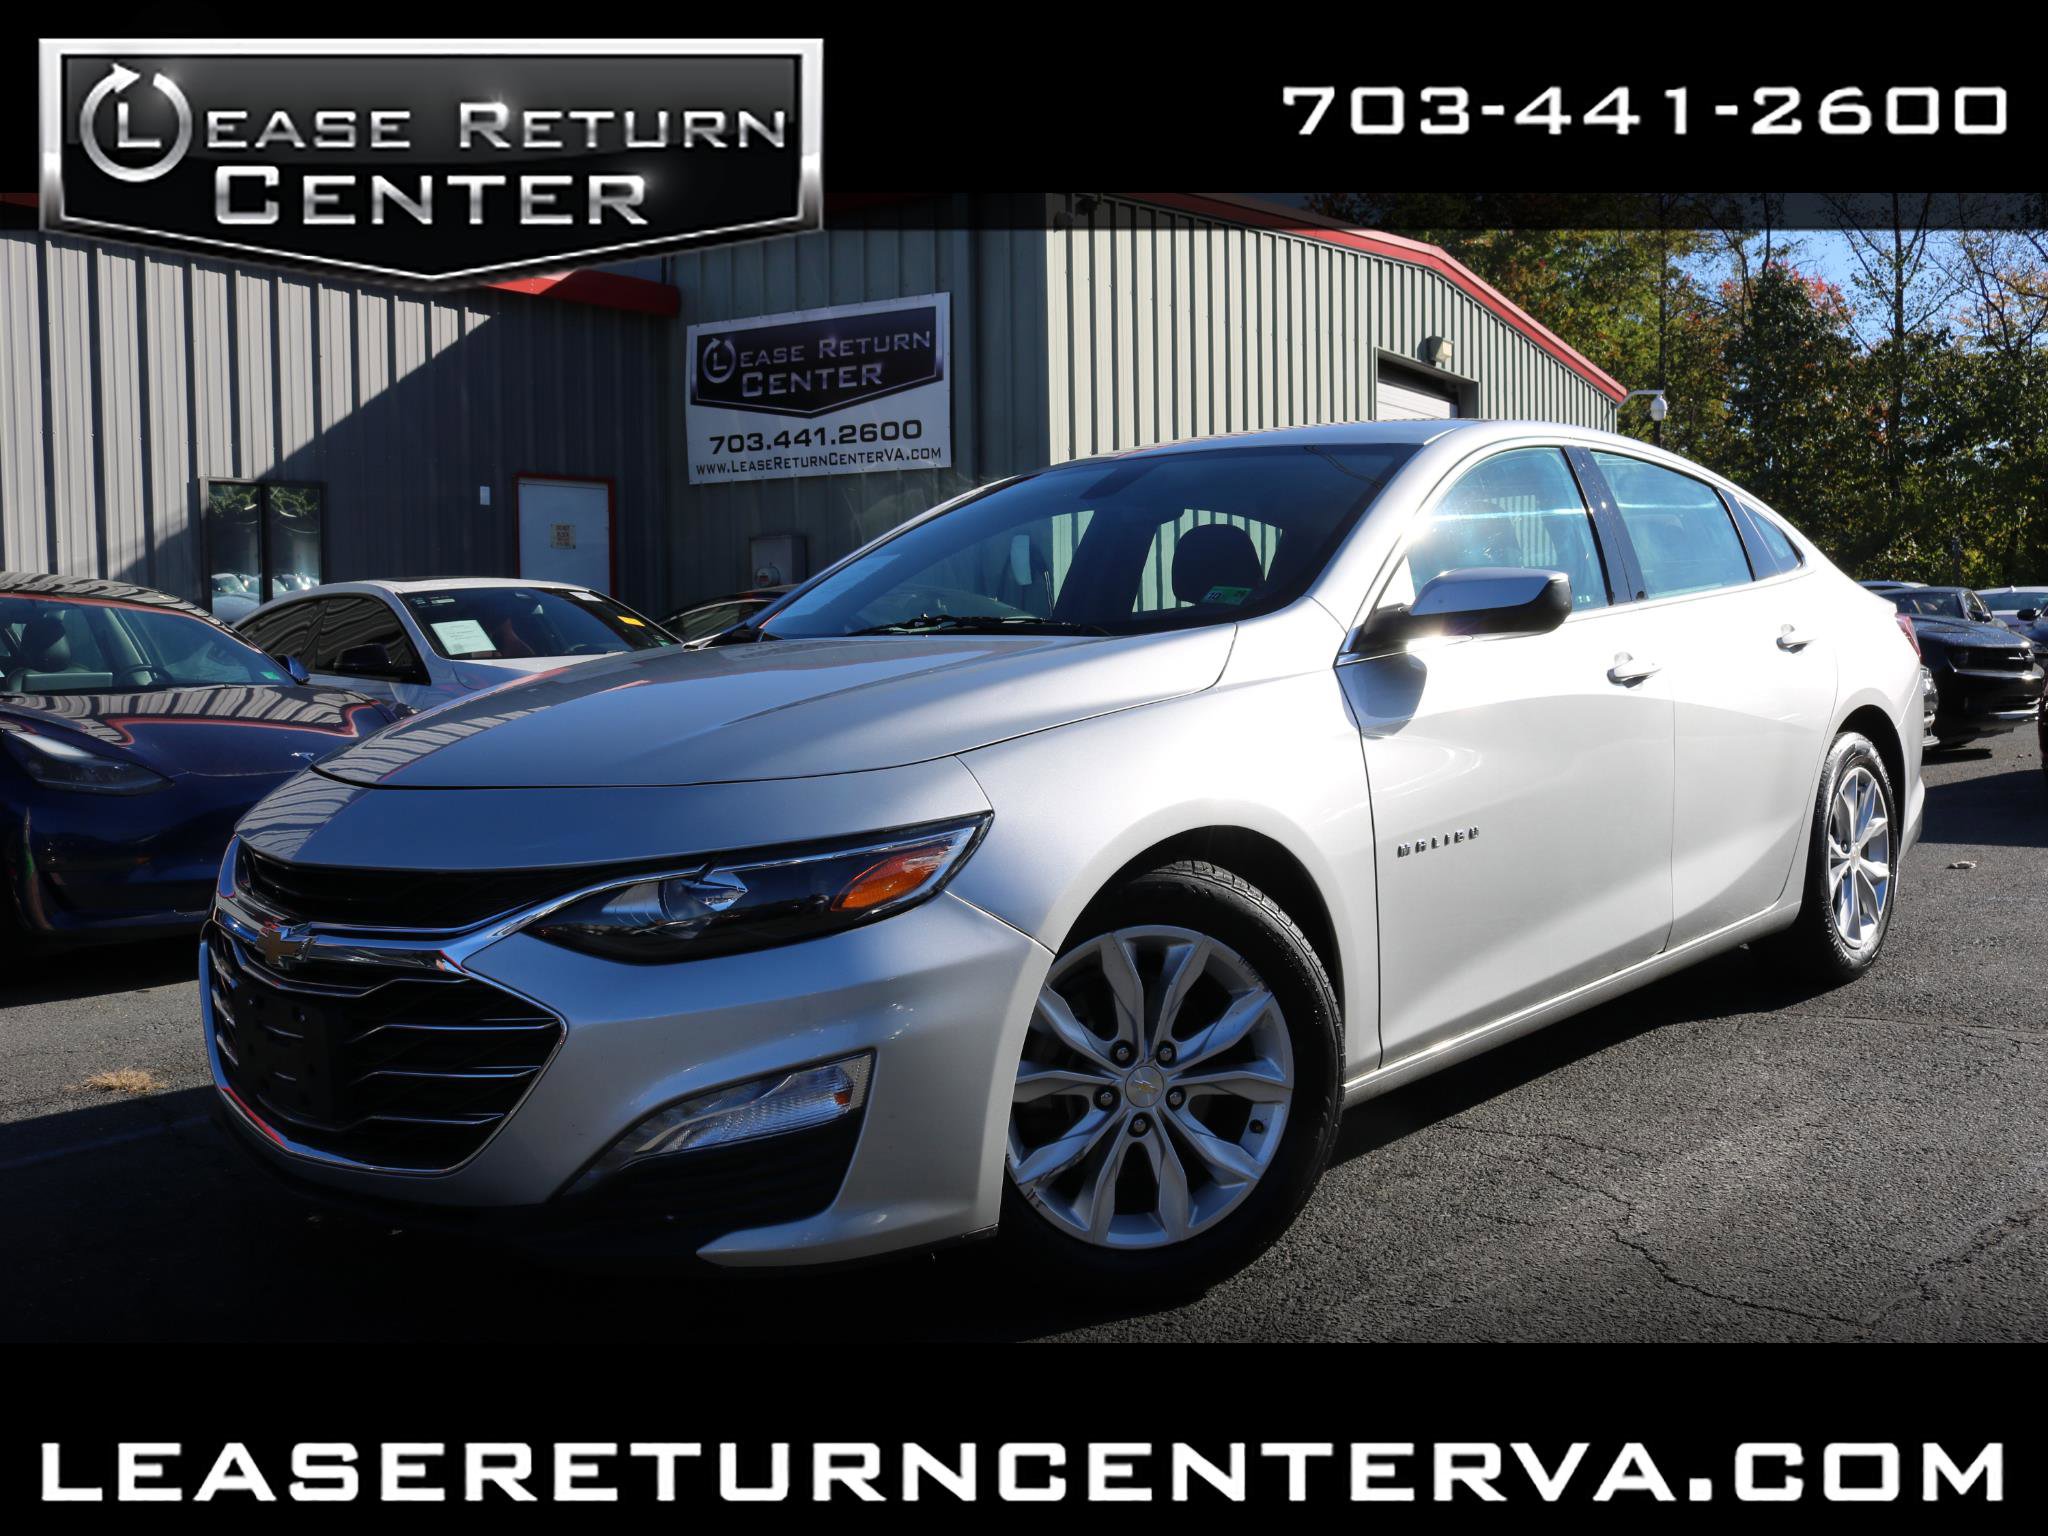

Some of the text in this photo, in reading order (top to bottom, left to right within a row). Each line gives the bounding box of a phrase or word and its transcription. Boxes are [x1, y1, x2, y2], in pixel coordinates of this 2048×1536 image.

[712, 331, 931, 371] LEASE RETURN
[742, 363, 884, 398] CENTER
[709, 420, 923, 455] 703.441.2600
